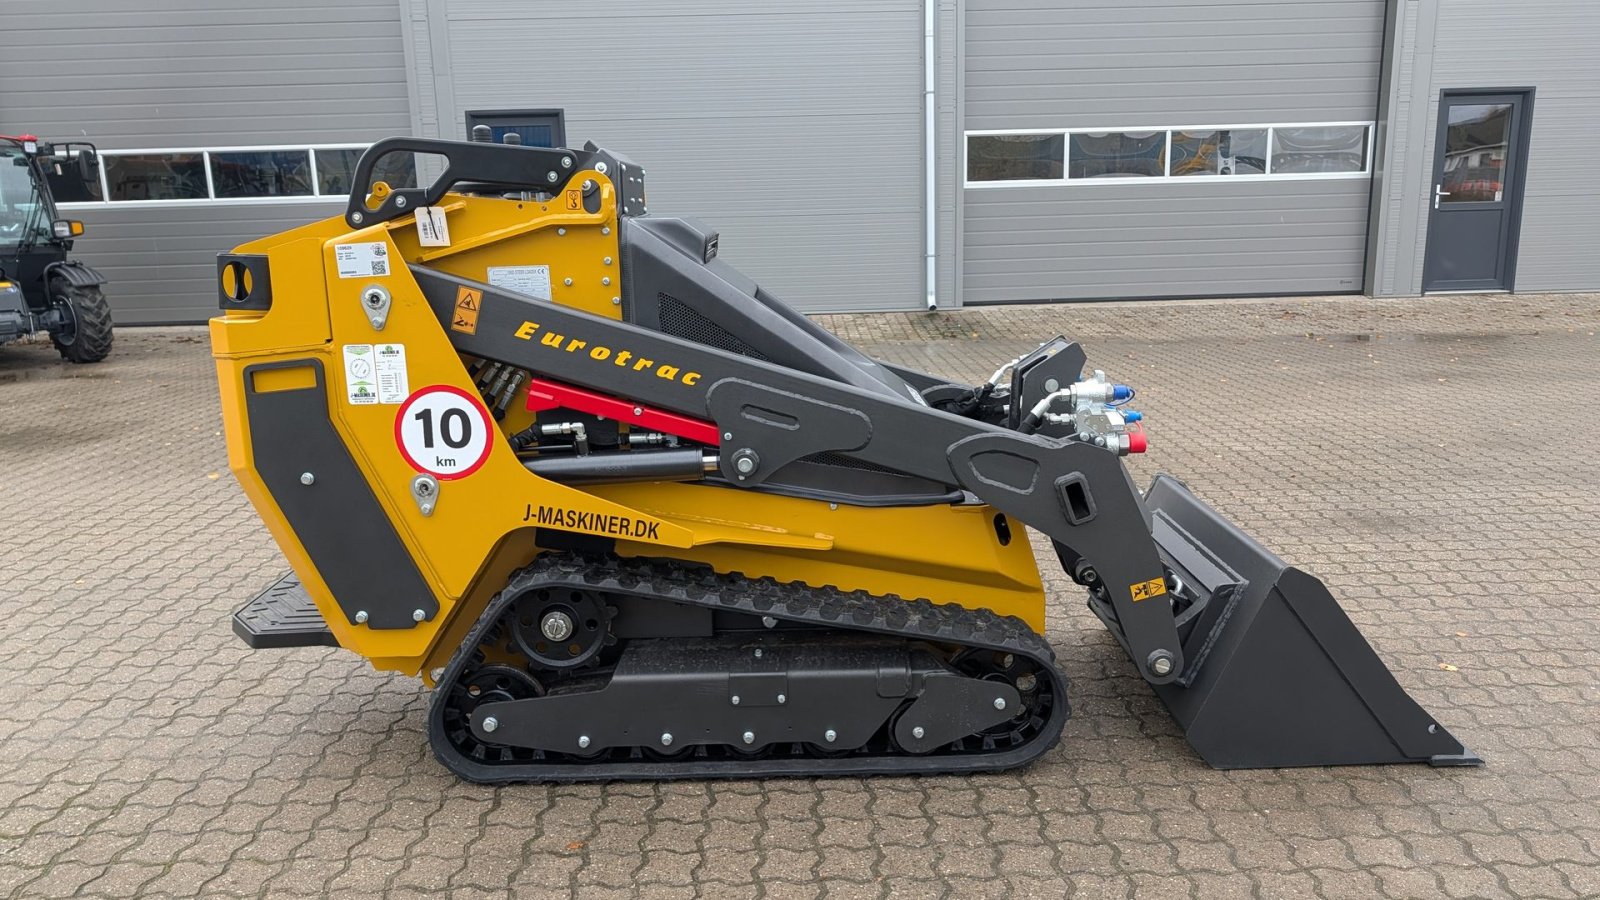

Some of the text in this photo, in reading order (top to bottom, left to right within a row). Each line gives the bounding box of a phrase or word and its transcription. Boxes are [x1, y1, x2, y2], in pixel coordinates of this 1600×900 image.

[513, 320, 702, 386] Eurotrac
[414, 407, 472, 449] 10
[436, 456, 456, 467] km
[523, 504, 660, 540] J-MASKINER.DK
